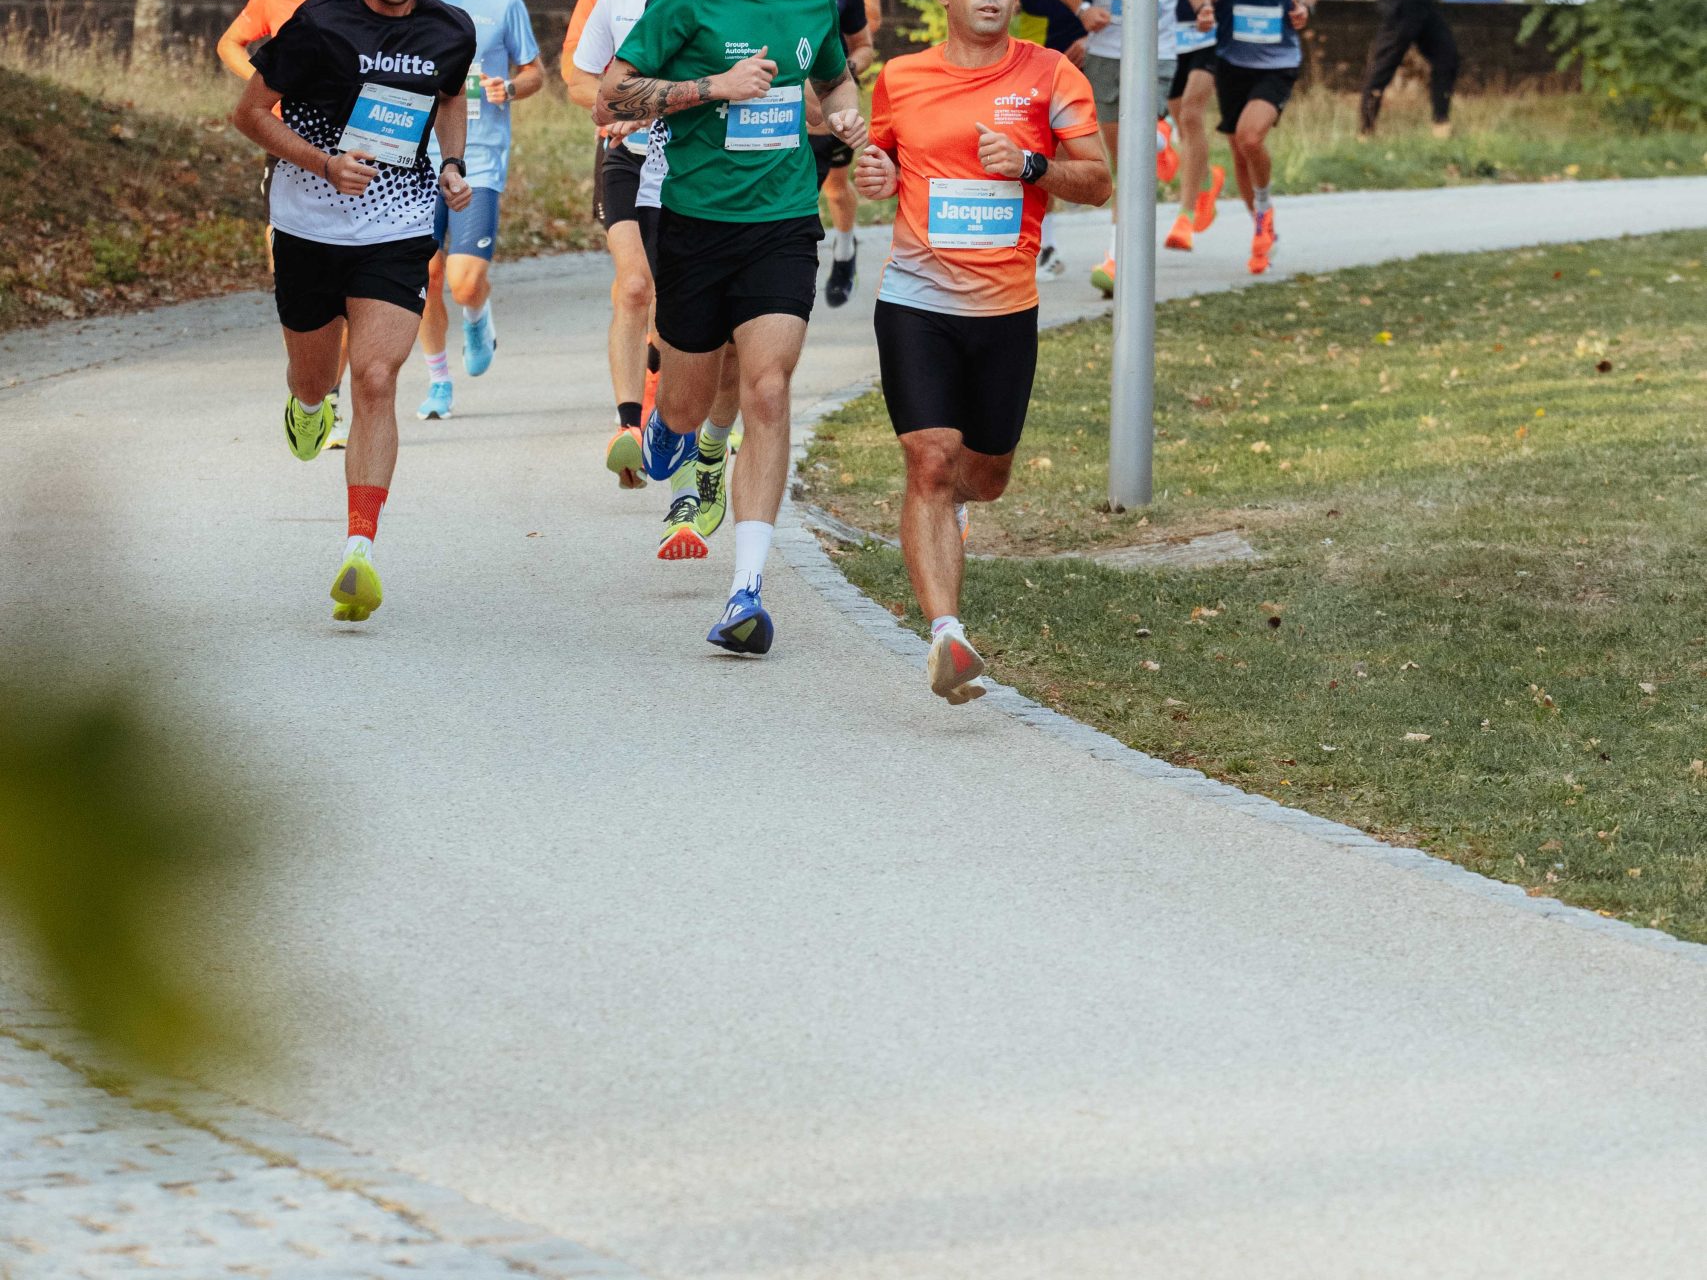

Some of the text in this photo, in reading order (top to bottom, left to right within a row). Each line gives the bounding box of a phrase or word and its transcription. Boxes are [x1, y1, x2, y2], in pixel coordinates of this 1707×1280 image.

[725, 41, 749, 49] Groupe
[994, 93, 1031, 108] cnfpc
[368, 104, 415, 128] Alexis
[740, 108, 794, 125] Bastien
[396, 155, 414, 166] 3191
[937, 201, 1014, 224] Jacques
